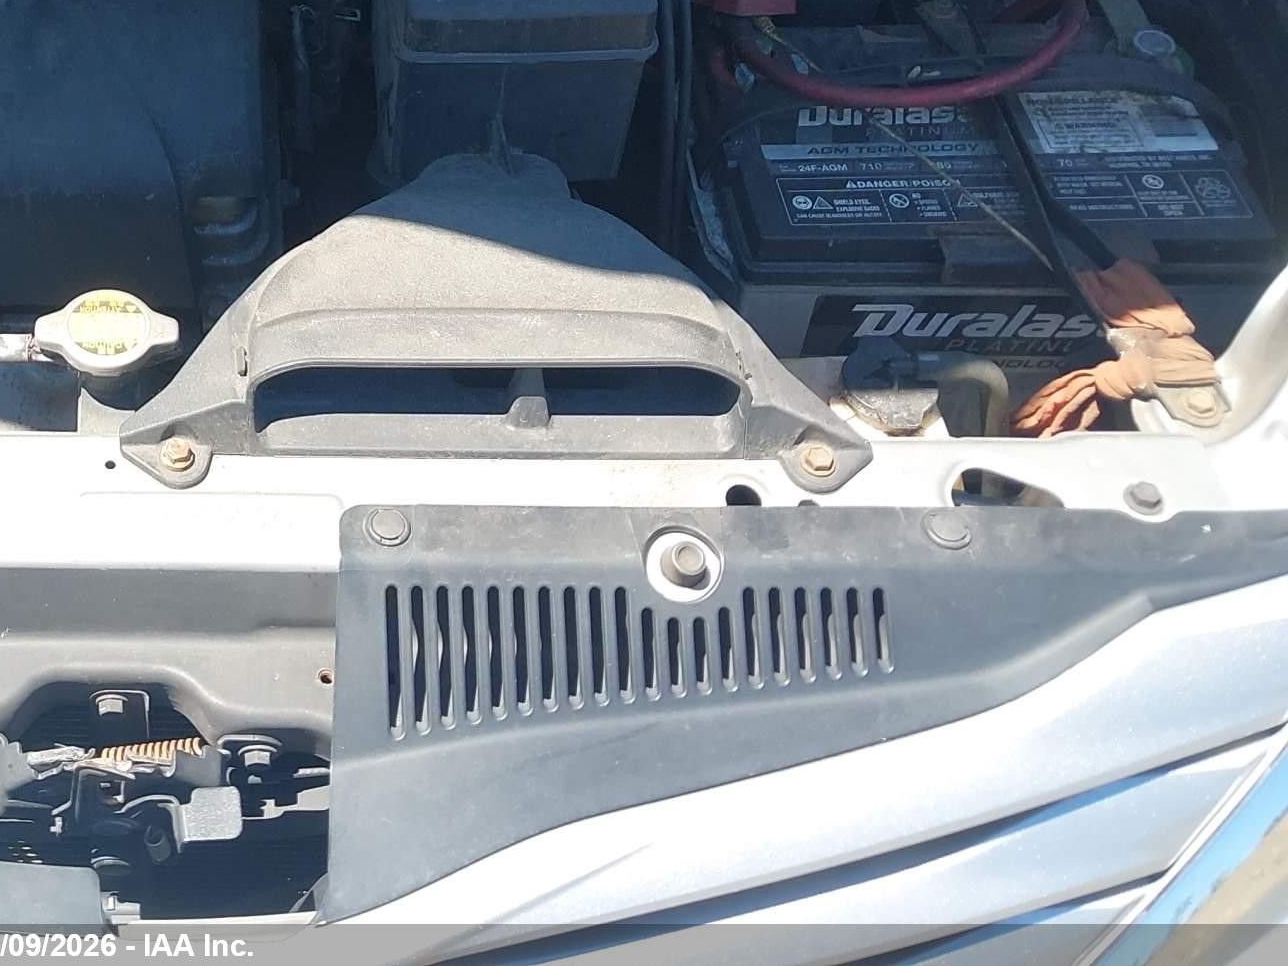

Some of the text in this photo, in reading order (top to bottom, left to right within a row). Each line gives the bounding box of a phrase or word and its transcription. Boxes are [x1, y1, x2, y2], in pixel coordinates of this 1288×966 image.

[865, 126, 976, 137] PATINUM
[807, 145, 849, 155] AGM
[798, 163, 848, 172] 24F-AGM
[861, 162, 882, 171] 710
[851, 303, 1098, 338] Duralas
